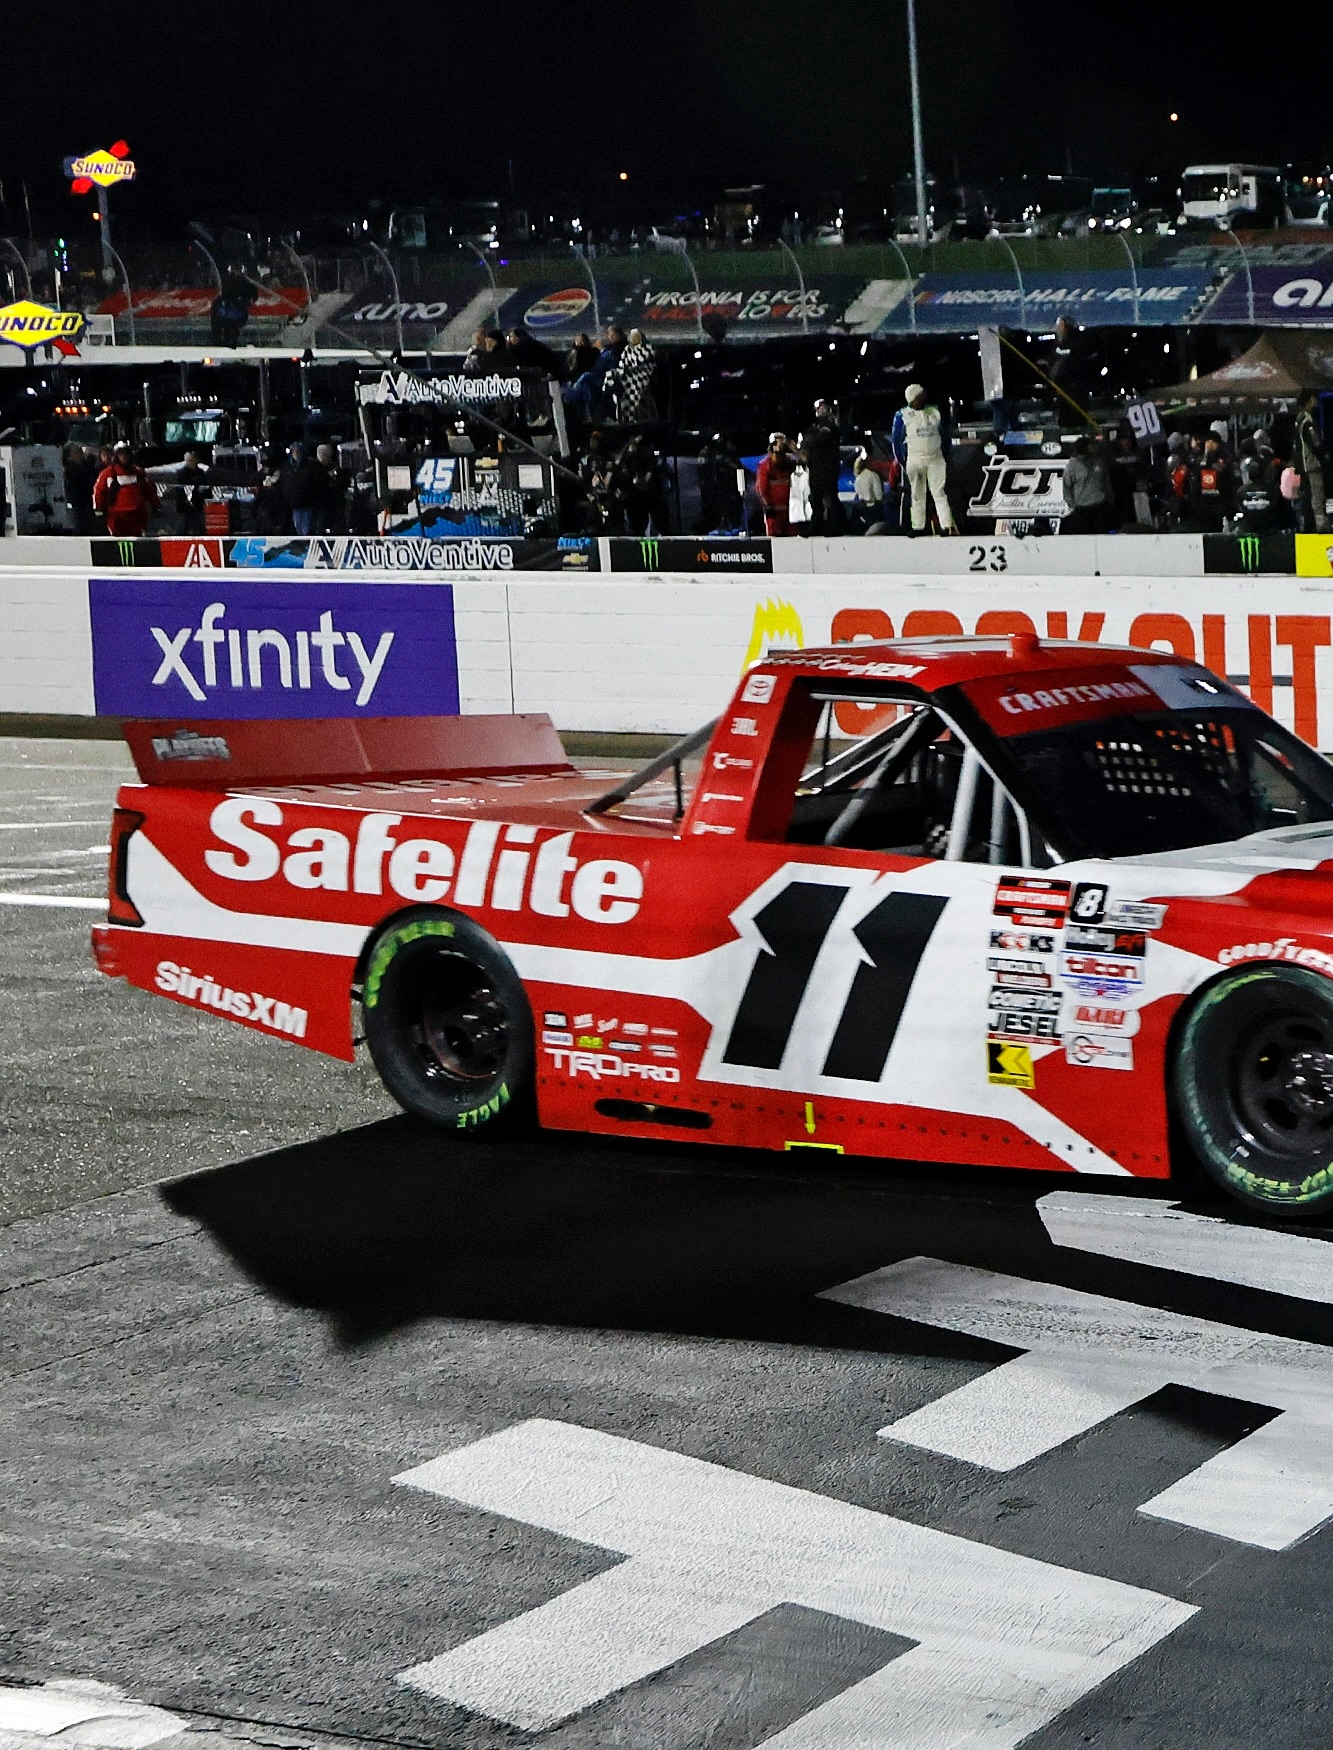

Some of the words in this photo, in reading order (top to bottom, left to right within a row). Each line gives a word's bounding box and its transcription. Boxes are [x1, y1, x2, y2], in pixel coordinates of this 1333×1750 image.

[75, 160, 133, 175] SUNOCO
[645, 290, 743, 306] VIRGINIA
[407, 374, 521, 399] AutoVentive
[1127, 401, 1162, 437] 90
[415, 457, 456, 491] 45
[229, 538, 267, 566] 45
[348, 538, 514, 569] AutoVentive
[711, 551, 739, 563] RITCHIE
[968, 545, 1008, 572] 23
[150, 603, 394, 706] xfinity
[858, 661, 928, 678] HEIM
[999, 680, 1152, 715] CRAFTSMAN
[204, 798, 644, 925] Safelite
[1073, 888, 1104, 918] 8
[721, 880, 951, 1083] 11
[155, 960, 308, 1038] SiriusXM
[544, 1048, 622, 1080] TRD
[621, 1062, 681, 1083] PRO
